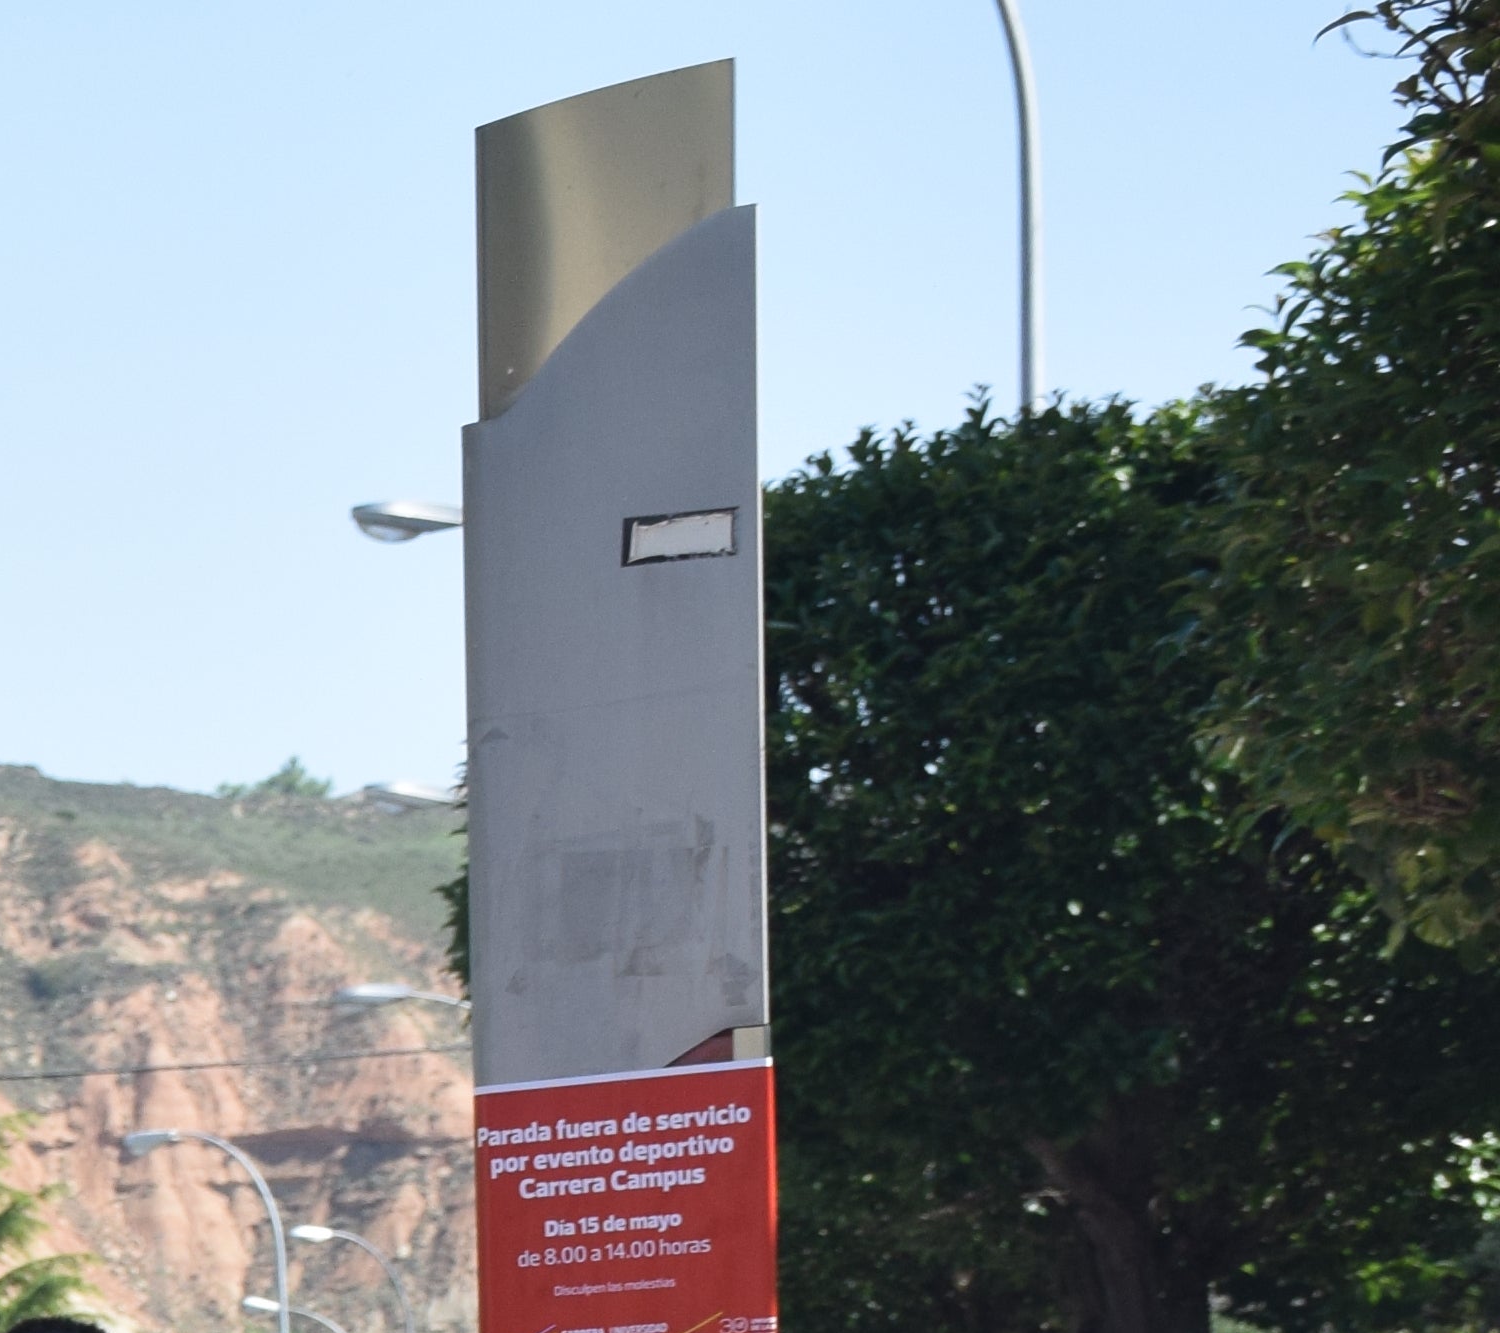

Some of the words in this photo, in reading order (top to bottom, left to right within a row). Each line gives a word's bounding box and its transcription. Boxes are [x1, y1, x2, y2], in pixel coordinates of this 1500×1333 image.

[477, 1121, 552, 1148] Parada
[555, 1119, 618, 1140] fuera
[622, 1112, 652, 1134] de
[656, 1103, 752, 1131] servicio
[490, 1156, 530, 1179] por
[533, 1146, 616, 1170] evento
[619, 1134, 735, 1165] deportivo
[519, 1177, 606, 1199] Carrera
[610, 1167, 707, 1192] Campus
[578, 1217, 600, 1234] 15
[603, 1215, 627, 1232] de
[629, 1213, 682, 1232] mayo
[517, 1250, 541, 1267] de
[544, 1246, 587, 1265] 8.00
[590, 1248, 602, 1261] a
[604, 1241, 655, 1260] 14.00
[658, 1239, 711, 1256] horas
[554, 1283, 606, 1297] Disculpen
[607, 1282, 623, 1293] las
[624, 1278, 676, 1291] molestias
